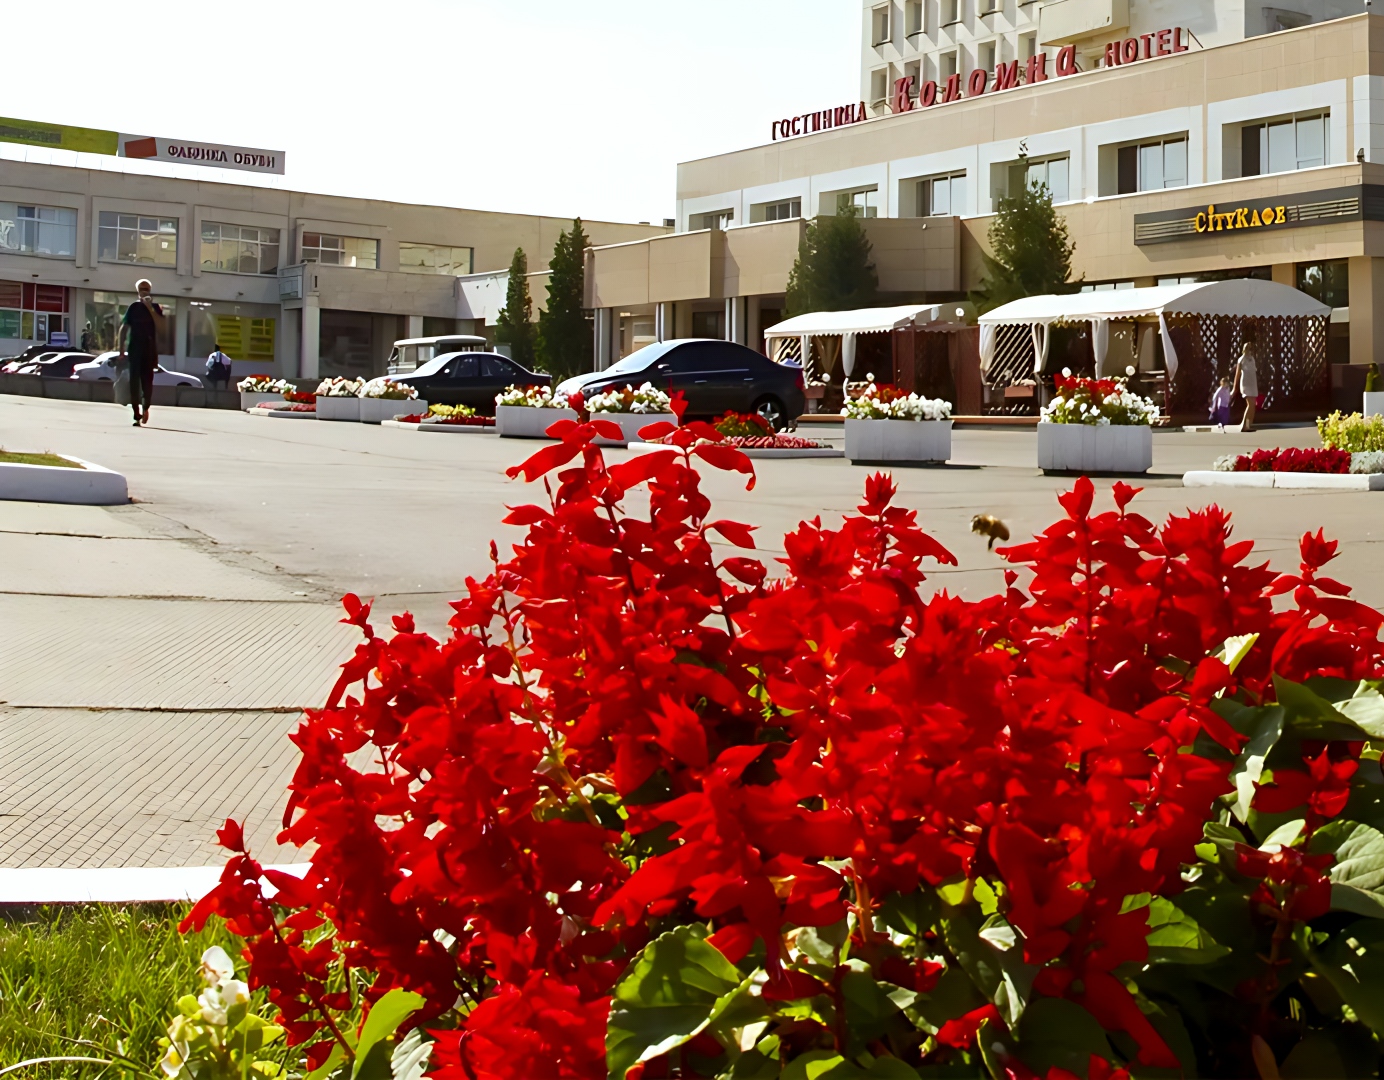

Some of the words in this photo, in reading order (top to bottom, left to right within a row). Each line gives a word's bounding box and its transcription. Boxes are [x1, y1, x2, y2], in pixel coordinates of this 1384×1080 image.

[772, 101, 868, 140] ГОСТИНИЦА
[892, 44, 1079, 114] Коломна
[1104, 27, 1189, 67] HOTEL
[233, 152, 275, 168] ОБУВИ
